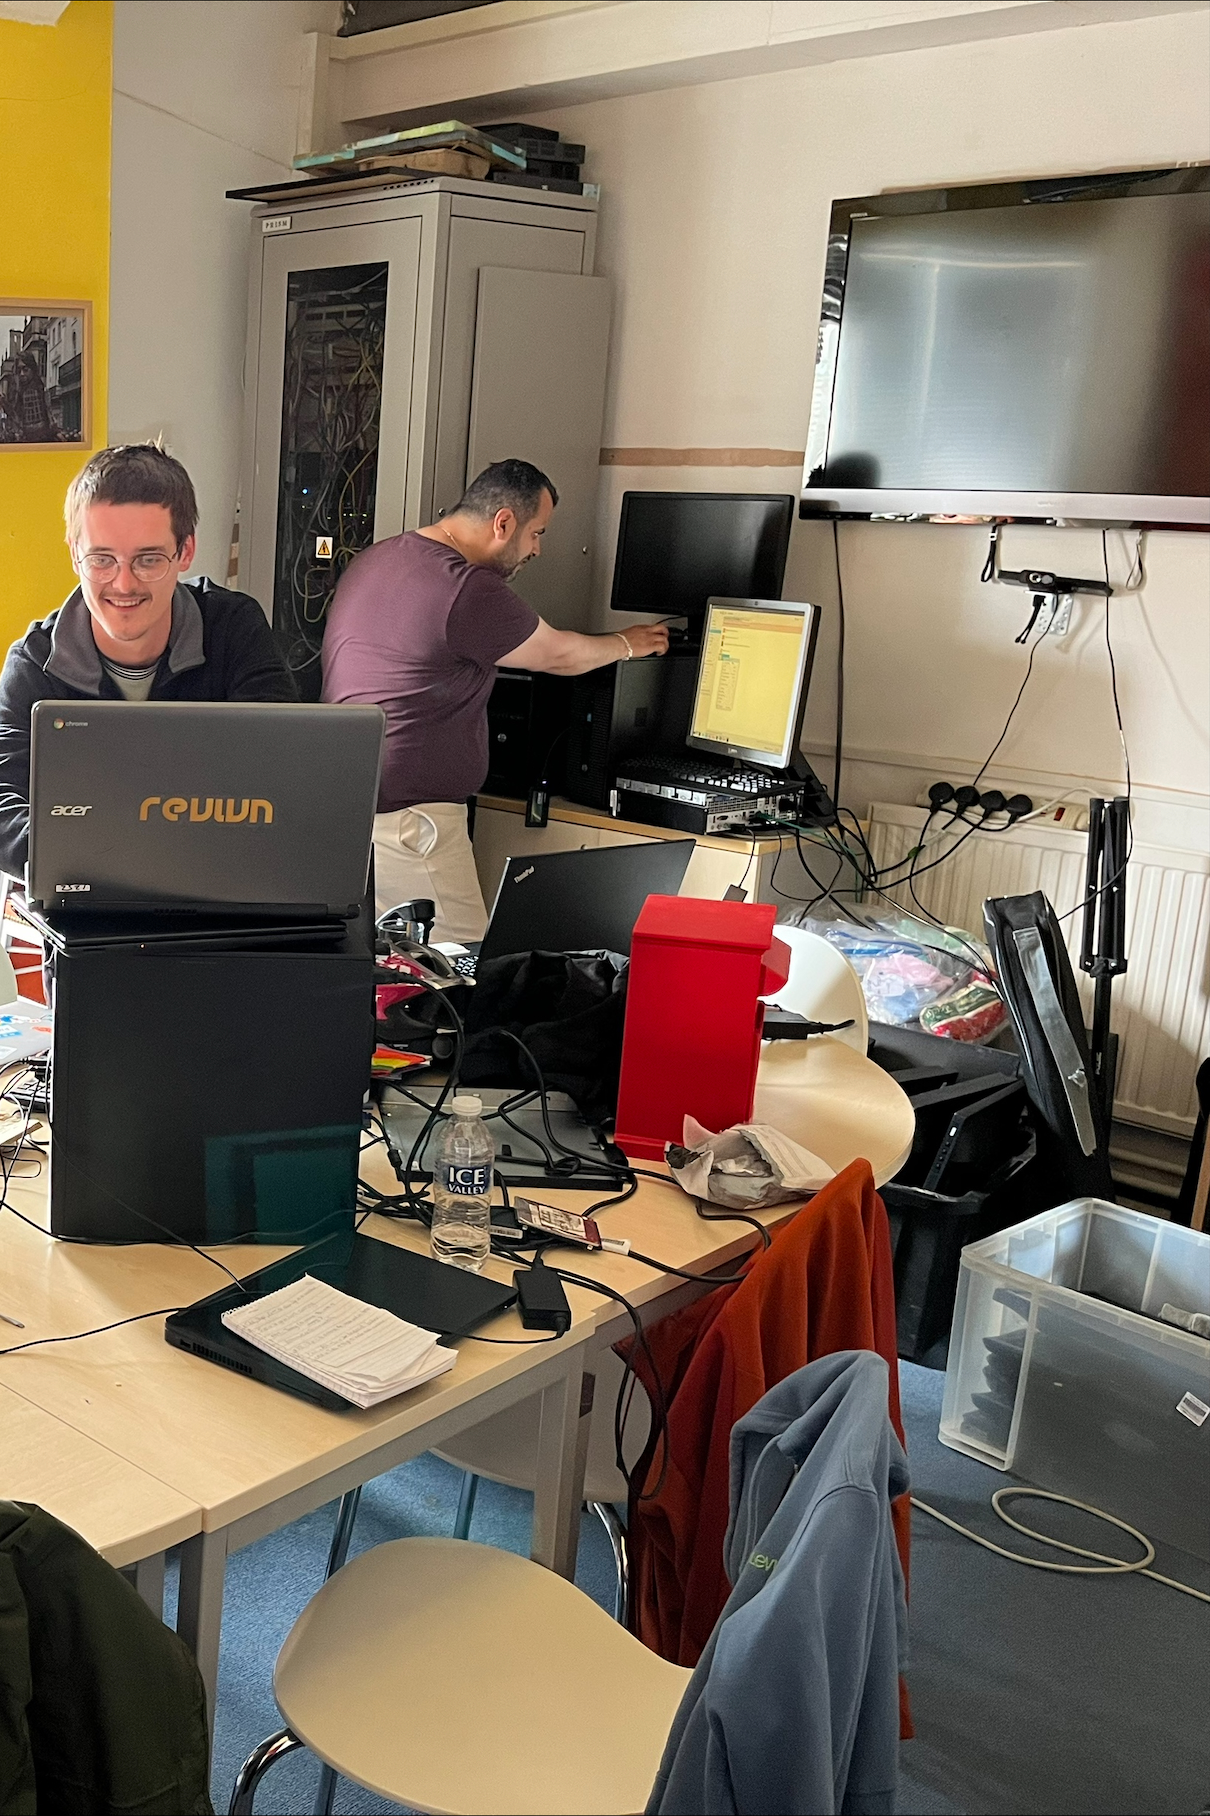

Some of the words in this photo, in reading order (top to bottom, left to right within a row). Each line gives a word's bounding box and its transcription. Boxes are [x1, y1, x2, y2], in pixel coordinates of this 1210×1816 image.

[265, 219, 288, 229] PRISM
[50, 805, 92, 816] acer
[449, 1165, 485, 1186] ICE
[448, 1183, 486, 1195] VALLEY
